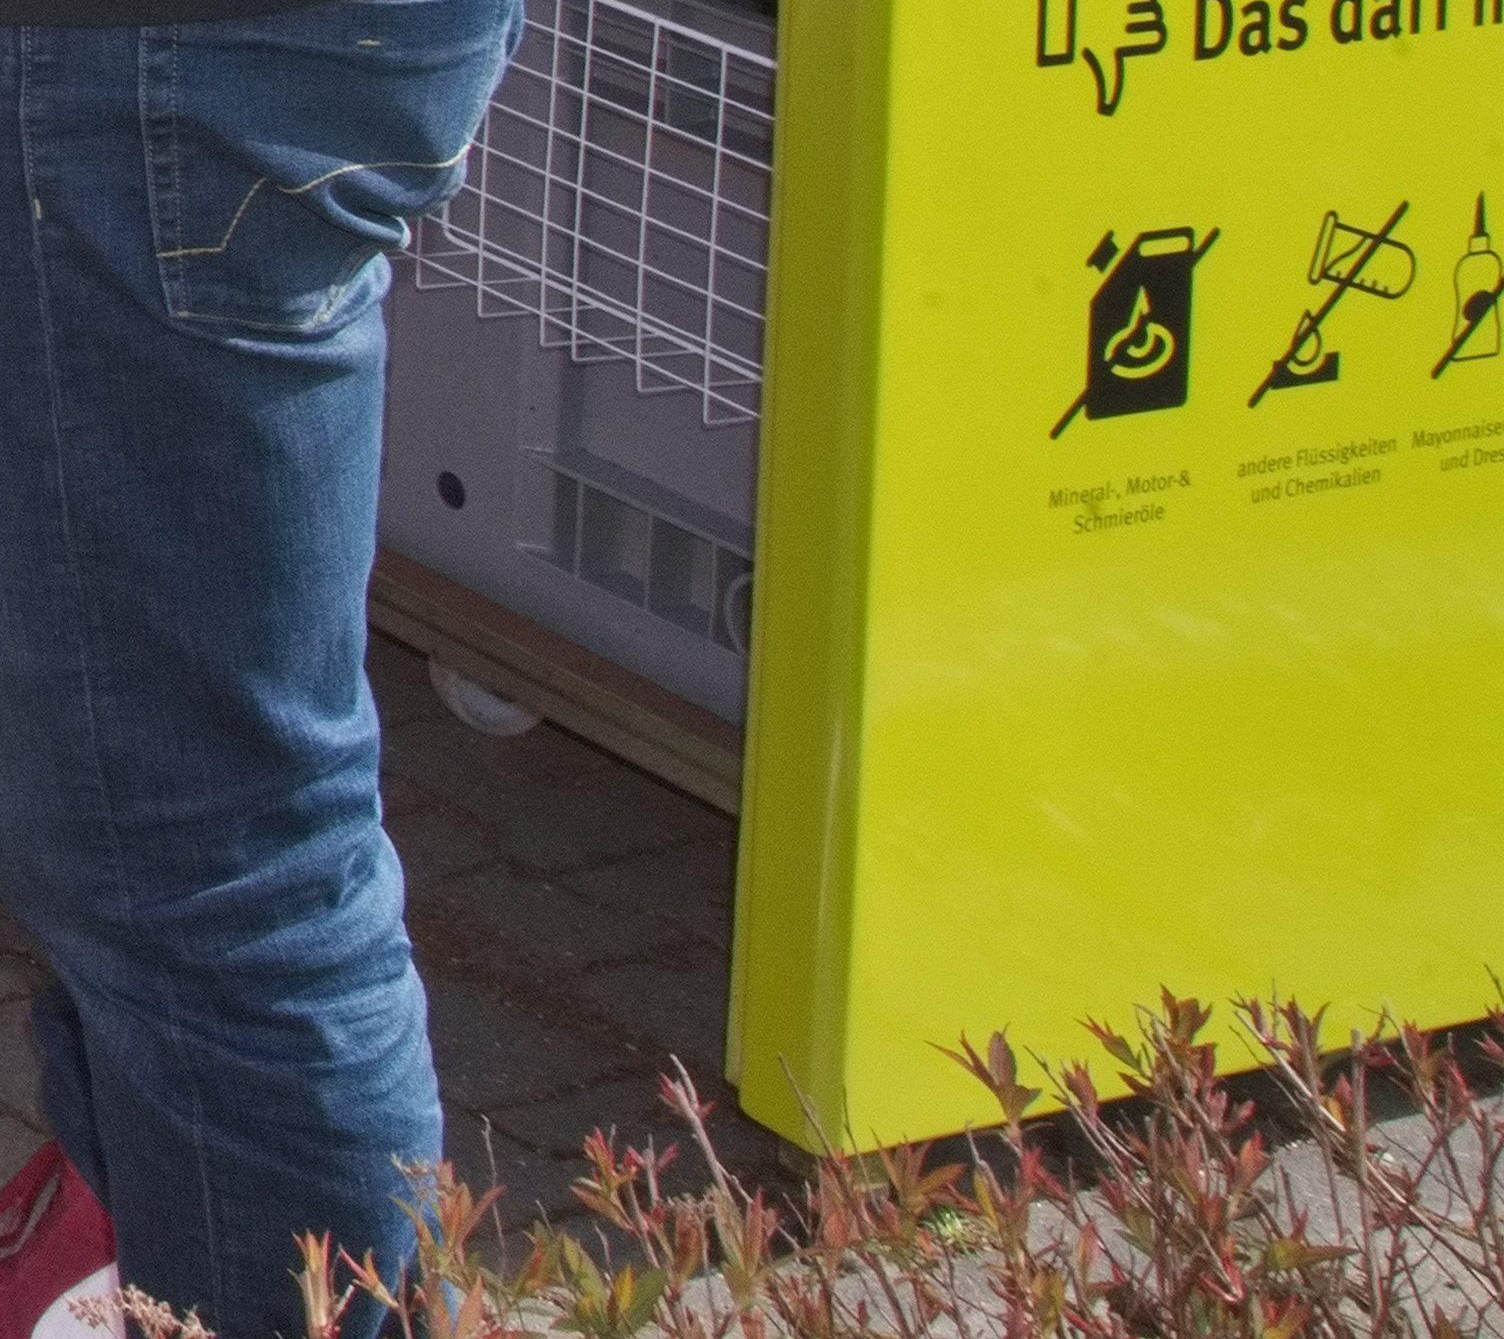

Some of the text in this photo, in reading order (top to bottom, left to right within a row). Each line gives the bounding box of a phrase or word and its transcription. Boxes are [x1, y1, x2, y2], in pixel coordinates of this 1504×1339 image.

[1238, 437, 1397, 479] andere Flüssigkeiten
[1440, 449, 1469, 472] und
[1251, 467, 1381, 504] und Chemikalien
[1073, 503, 1165, 535] Schmieröle
